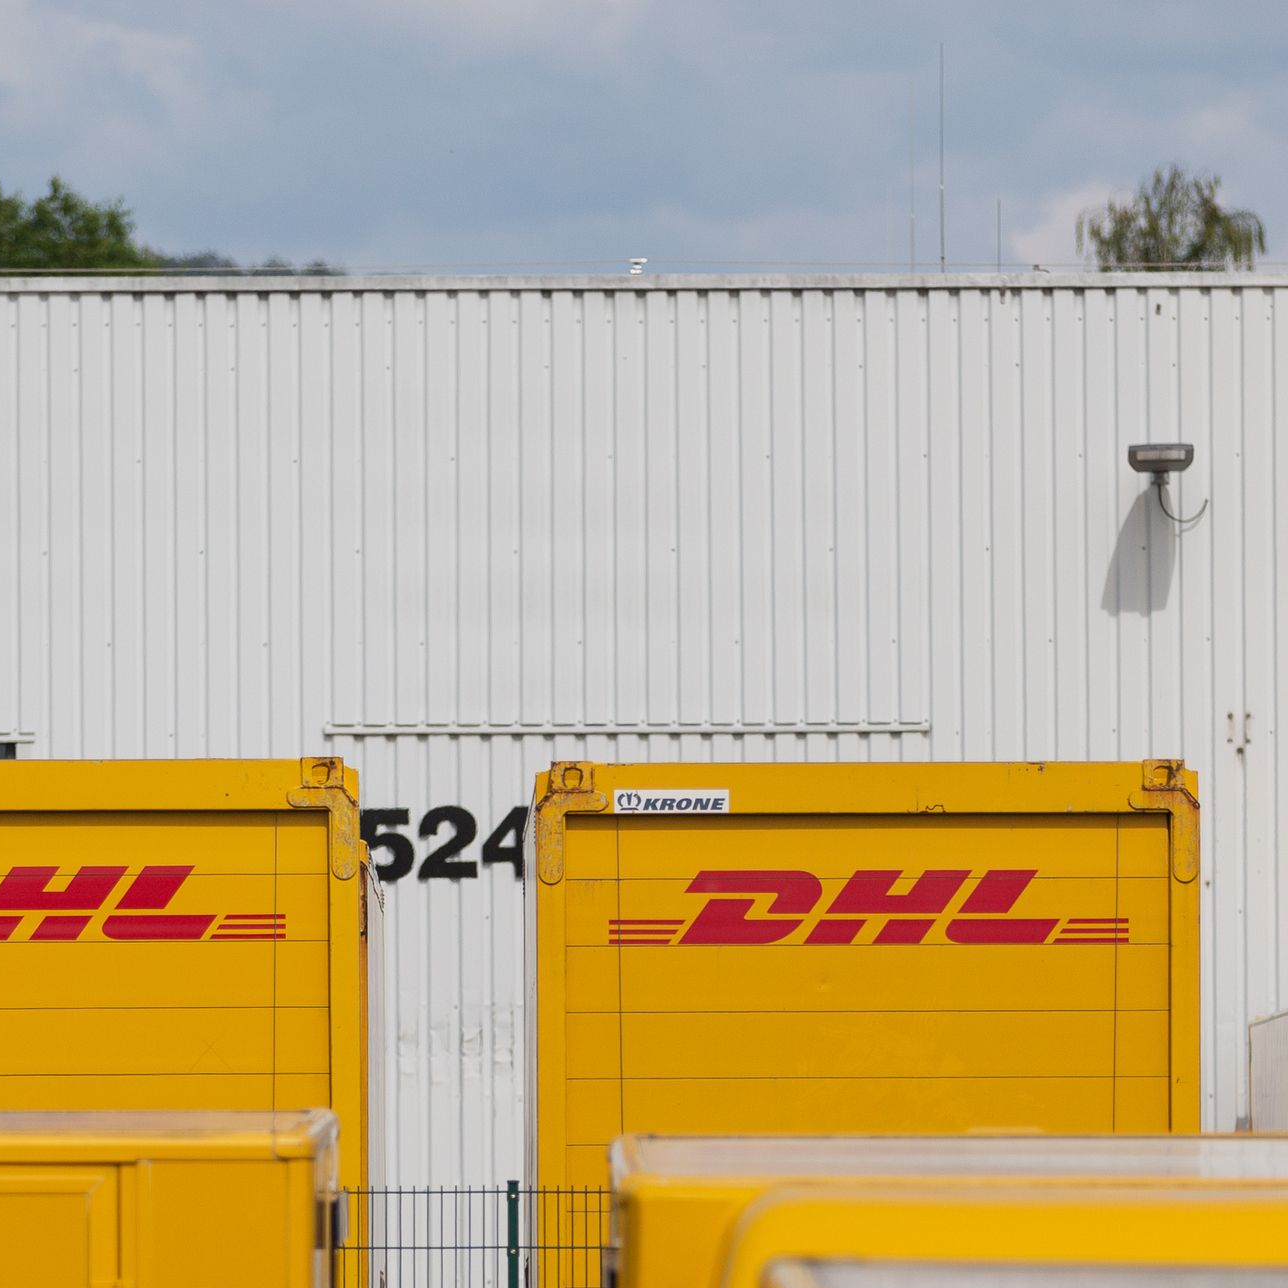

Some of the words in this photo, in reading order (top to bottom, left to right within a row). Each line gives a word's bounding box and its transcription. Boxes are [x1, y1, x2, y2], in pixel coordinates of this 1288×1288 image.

[642, 797, 725, 811] KRONE
[360, 805, 529, 882] 524
[678, 869, 1060, 945] DHL
